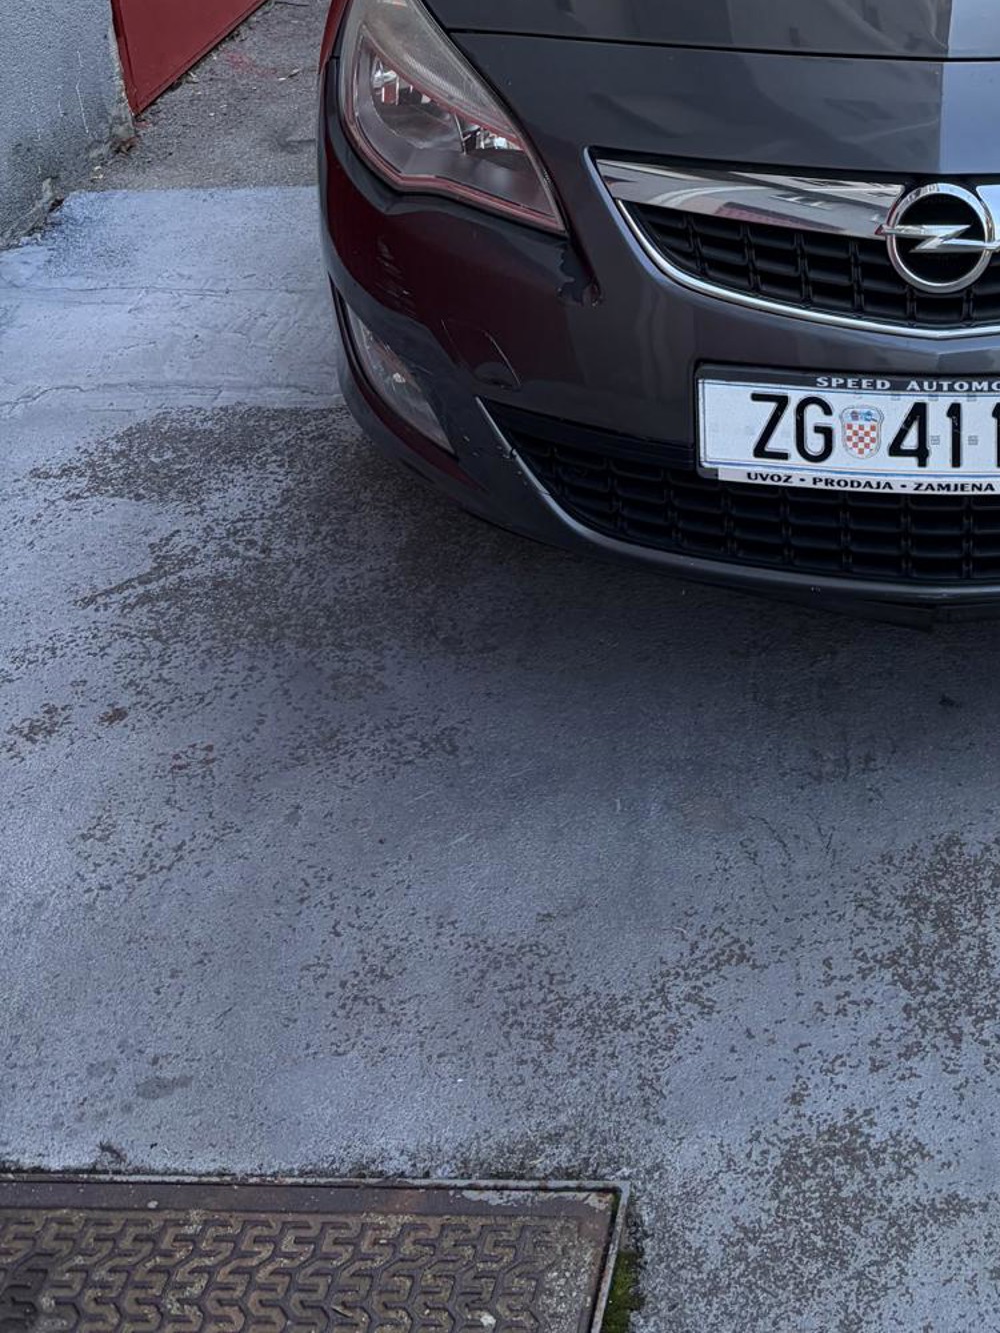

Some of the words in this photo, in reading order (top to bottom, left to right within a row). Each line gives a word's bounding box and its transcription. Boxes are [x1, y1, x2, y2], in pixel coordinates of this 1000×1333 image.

[816, 376, 891, 390] SPEED
[750, 392, 833, 463] ZG
[747, 472, 793, 484] UVOZ
[812, 477, 894, 490] PRODAJA
[913, 482, 995, 492] ZAMJENA
